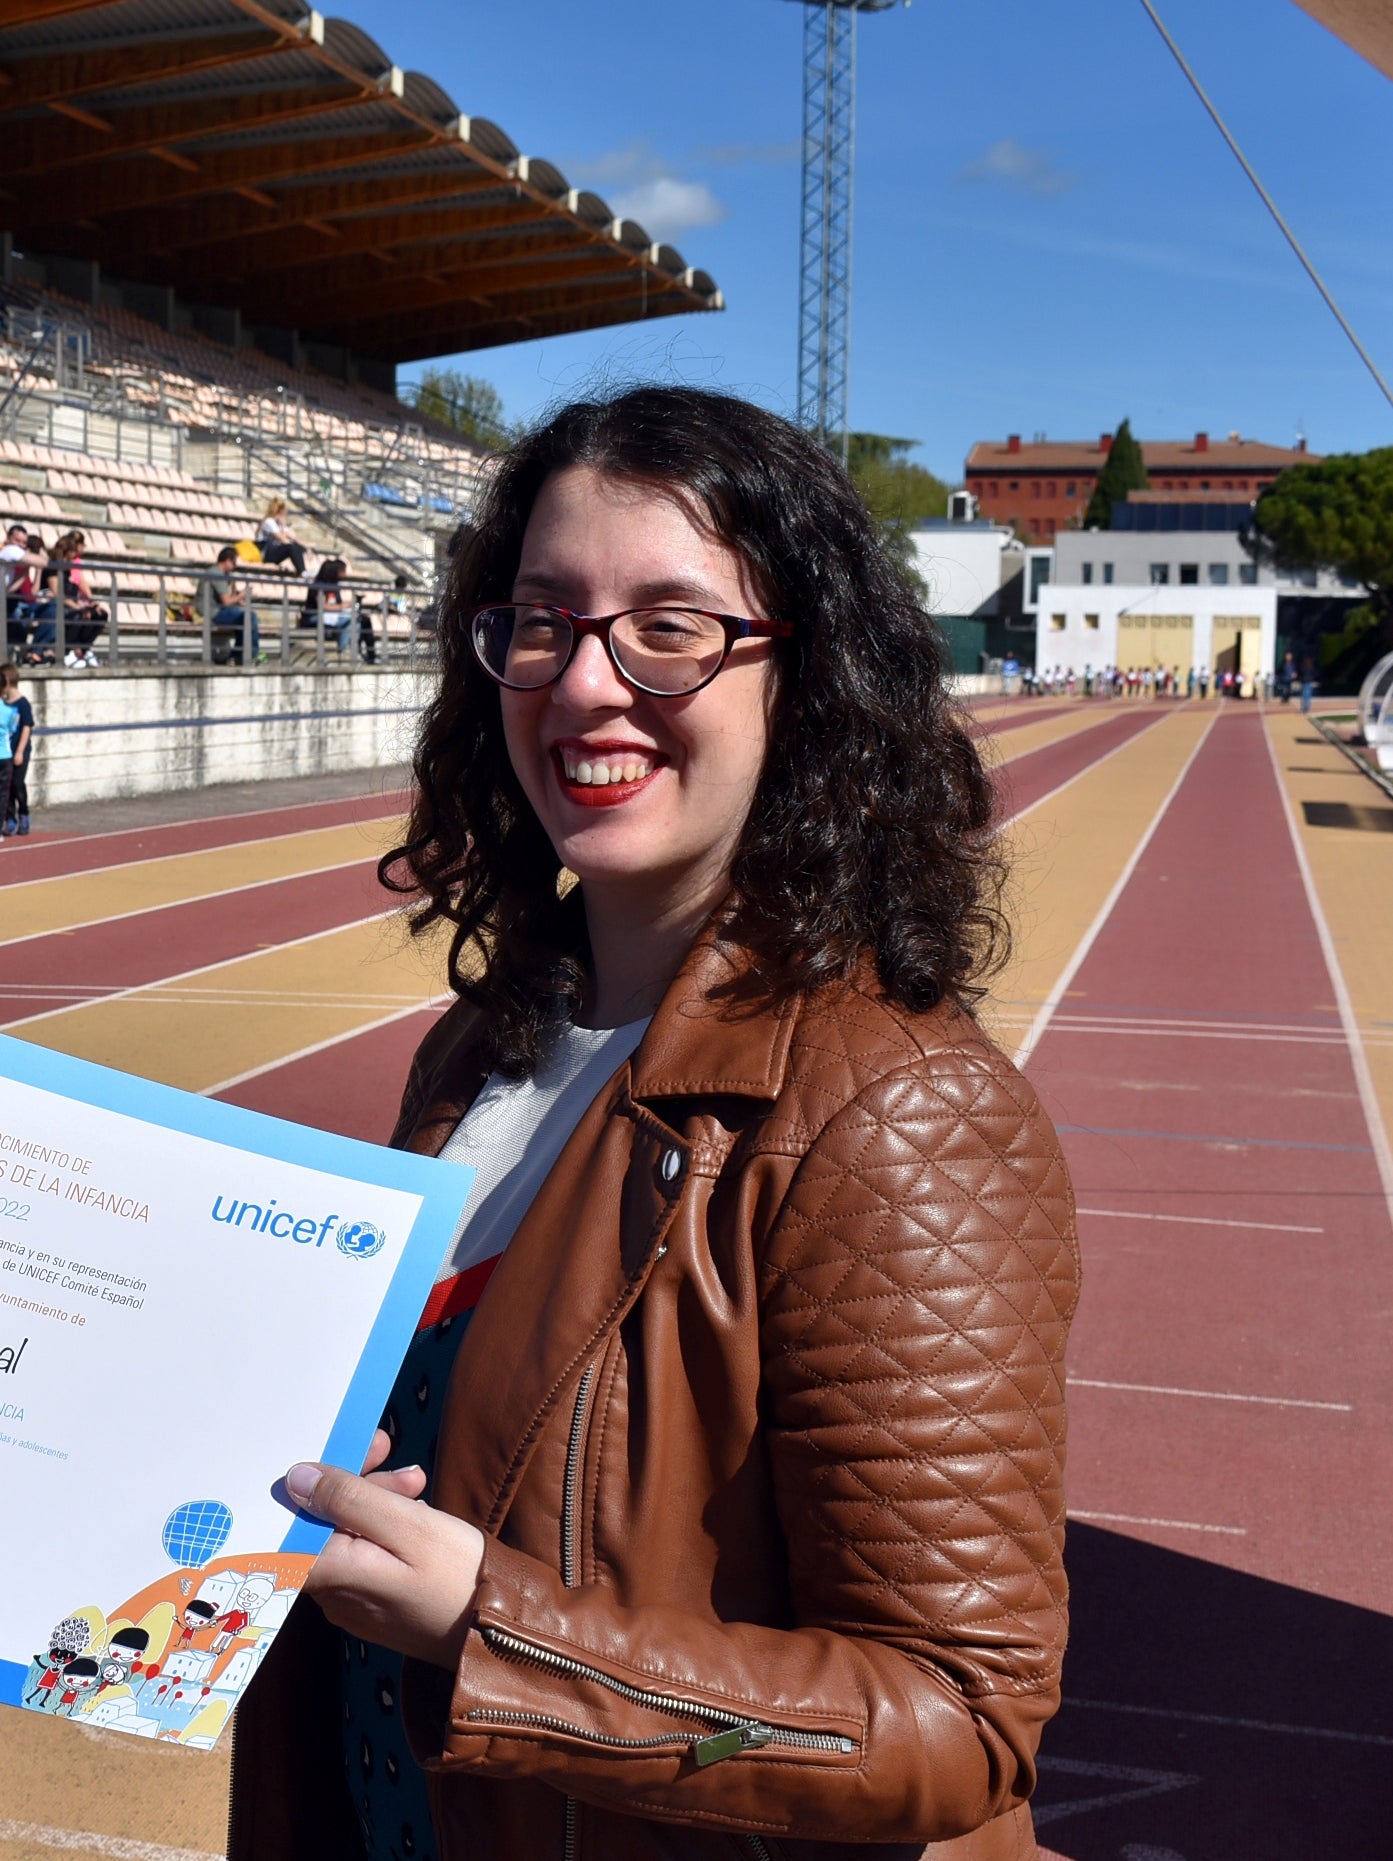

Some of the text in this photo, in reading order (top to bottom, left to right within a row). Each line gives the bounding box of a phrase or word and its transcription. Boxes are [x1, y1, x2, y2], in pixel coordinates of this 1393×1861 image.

[71, 1157, 92, 1175] DE
[10, 1165, 37, 1187] DE
[38, 1173, 59, 1196] LA
[65, 1182, 148, 1223] INFANCIA
[211, 1195, 338, 1248] unicef
[2, 1258, 16, 1271] de
[18, 1262, 60, 1284] UNICEF
[61, 1275, 99, 1296] Comité
[101, 1287, 144, 1310] Español
[27, 1249, 35, 1260] y
[36, 1252, 50, 1263] en
[52, 1257, 66, 1267] su
[67, 1262, 147, 1292] representación
[71, 1313, 86, 1326] de
[12, 1438, 18, 1446] y
[18, 1440, 69, 1460] adolescentes
